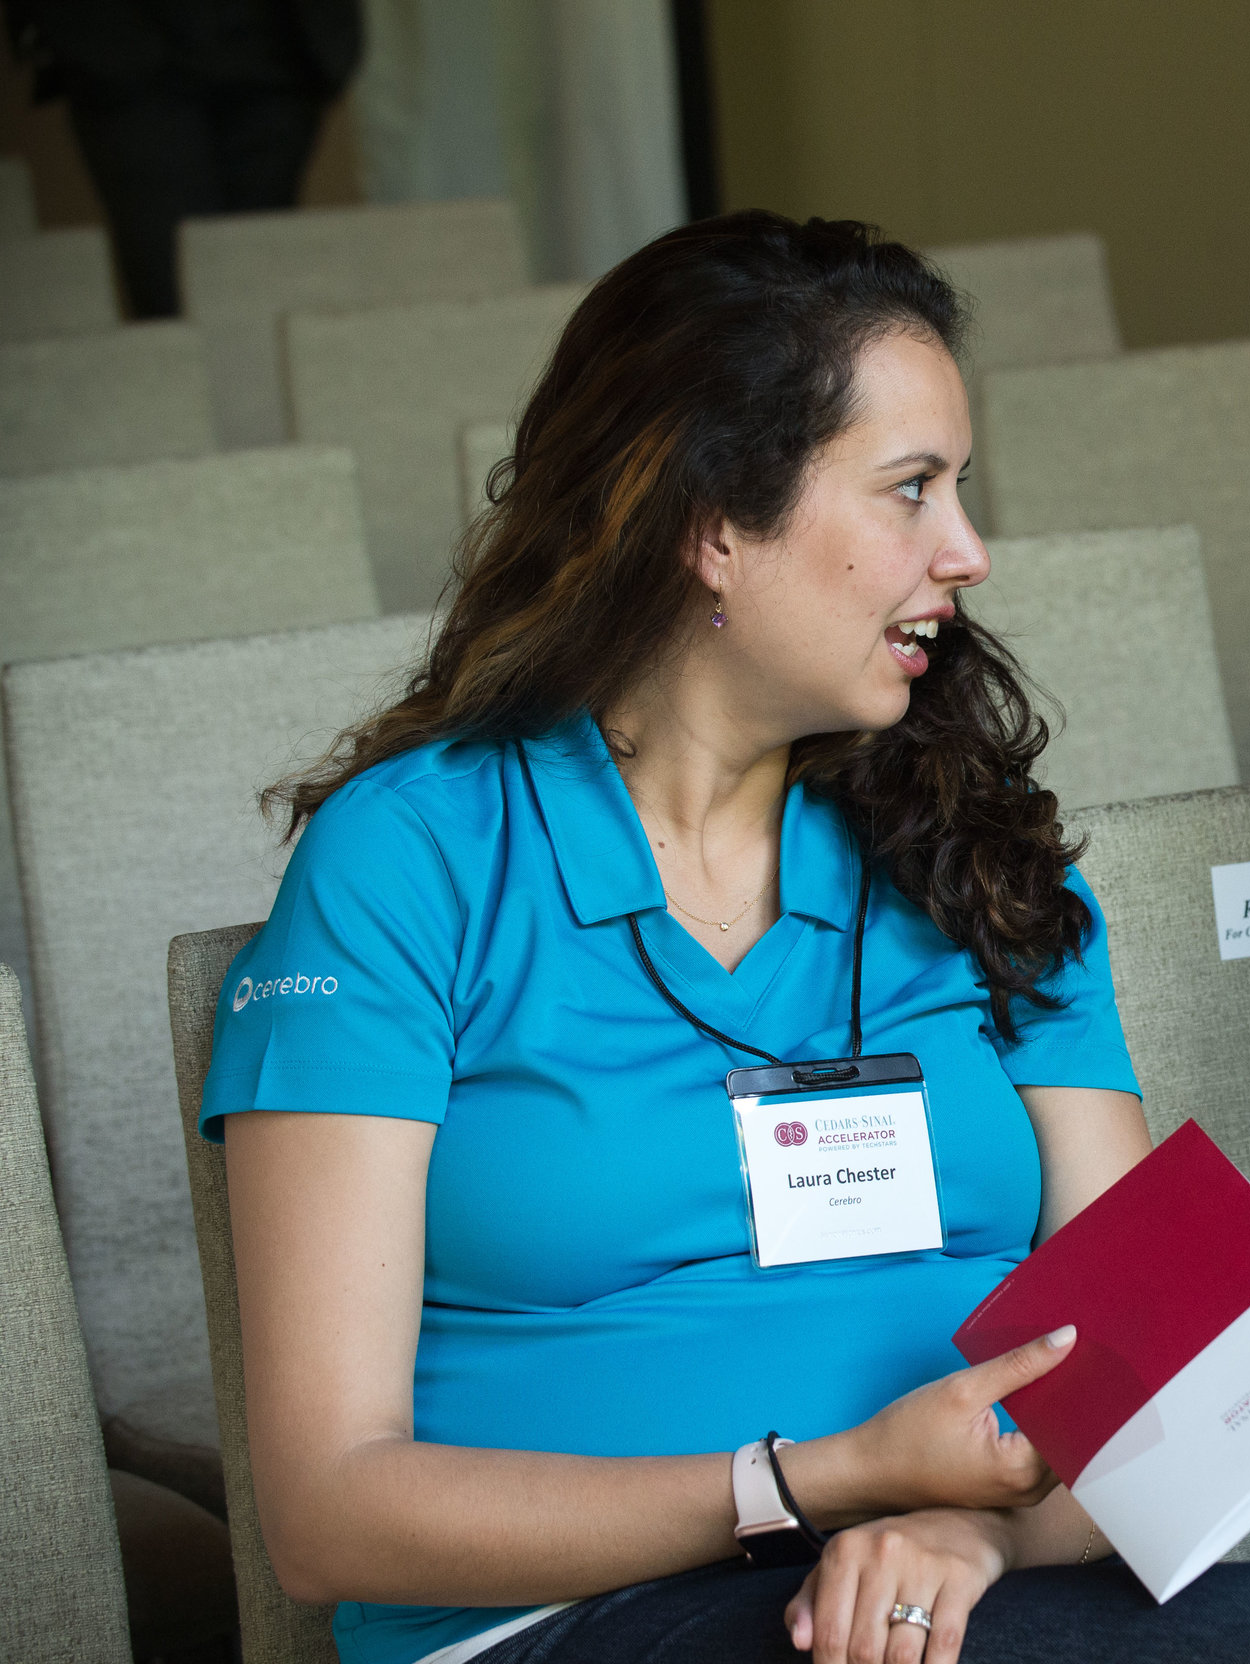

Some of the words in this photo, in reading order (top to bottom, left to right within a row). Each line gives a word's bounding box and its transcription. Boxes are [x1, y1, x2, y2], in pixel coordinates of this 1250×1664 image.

[1225, 929, 1243, 940] For
[253, 972, 338, 1001] cerebro
[818, 1129, 896, 1144] ACCELERATOR
[818, 1144, 850, 1152] POWERED
[852, 1142, 860, 1150] BY
[862, 1141, 897, 1149] TECHSTARS
[788, 1173, 832, 1188] Laura
[836, 1167, 896, 1184] Chester
[829, 1196, 862, 1206] Cerebro
